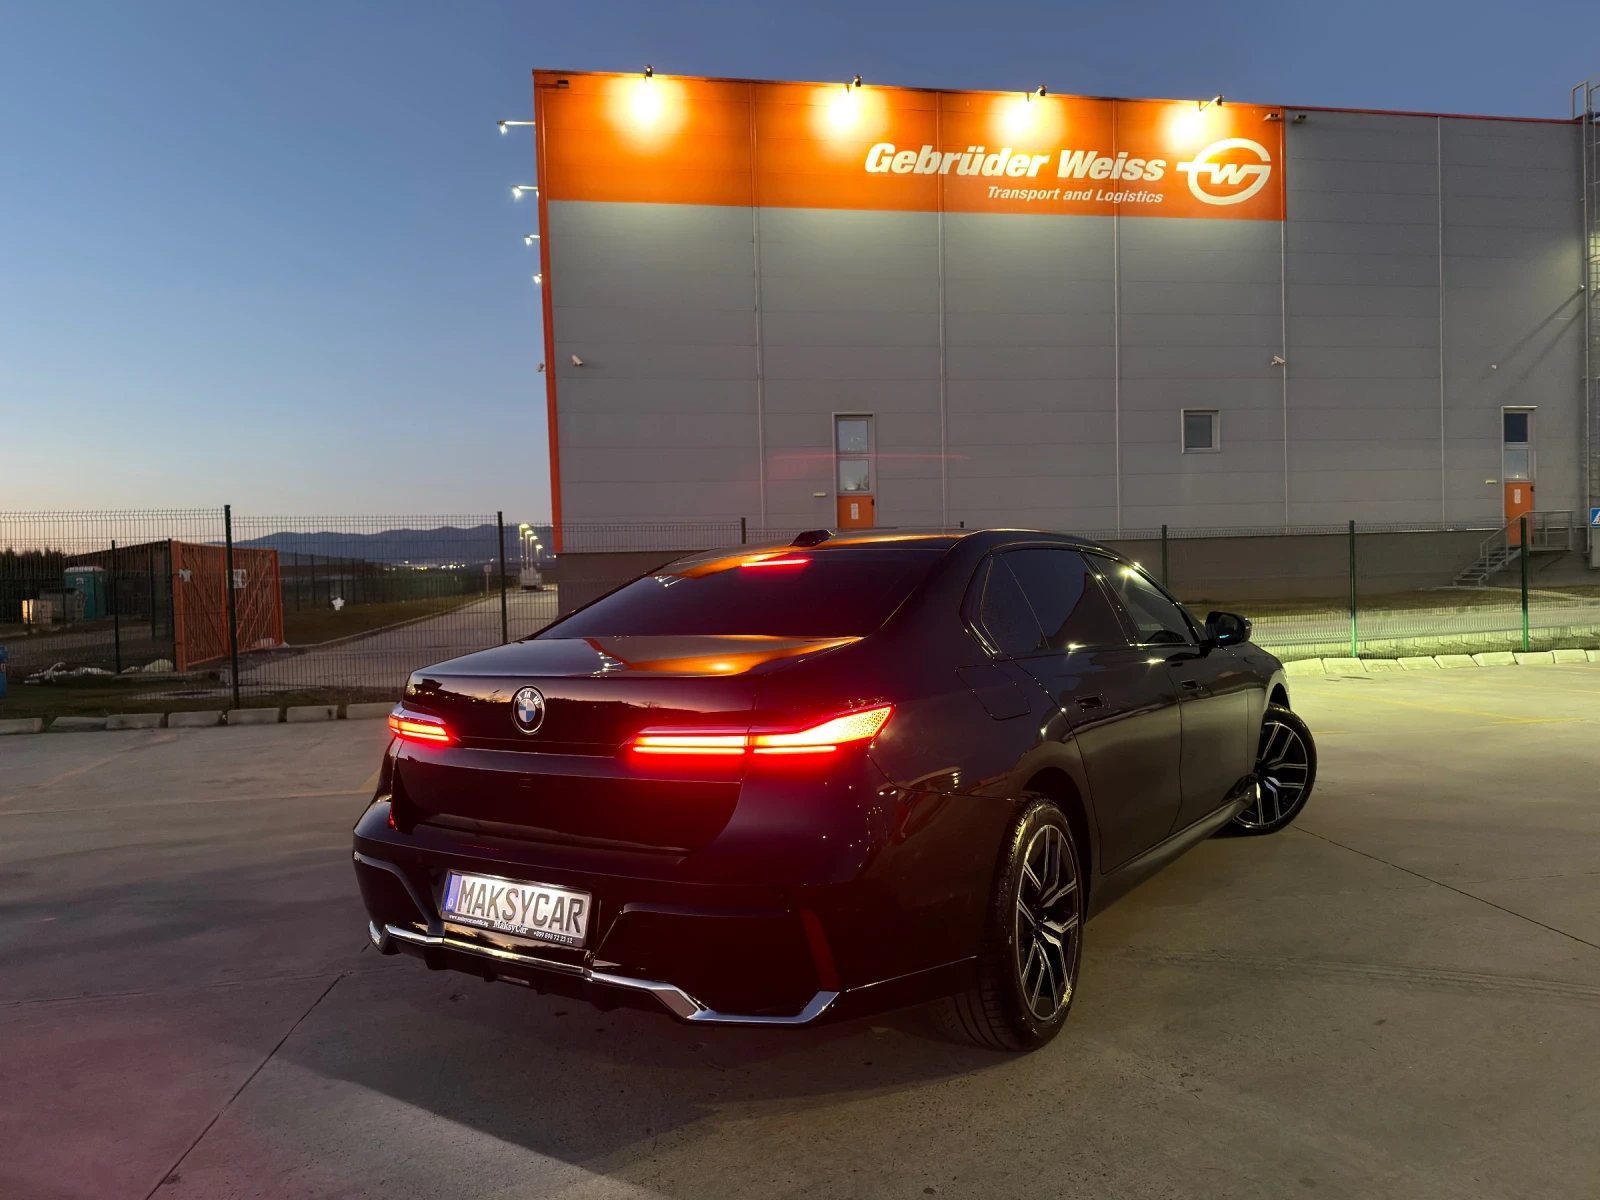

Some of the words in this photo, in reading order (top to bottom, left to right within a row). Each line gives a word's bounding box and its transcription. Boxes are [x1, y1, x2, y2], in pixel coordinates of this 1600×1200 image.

[864, 142, 1050, 177] Gebrüder
[1057, 149, 1167, 182] Weiss
[987, 185, 1061, 202] Transport
[1062, 188, 1093, 202] and
[1095, 189, 1164, 204] Logistics
[457, 879, 584, 934] MAKSYCAR
[493, 919, 529, 935] MaksyCar
